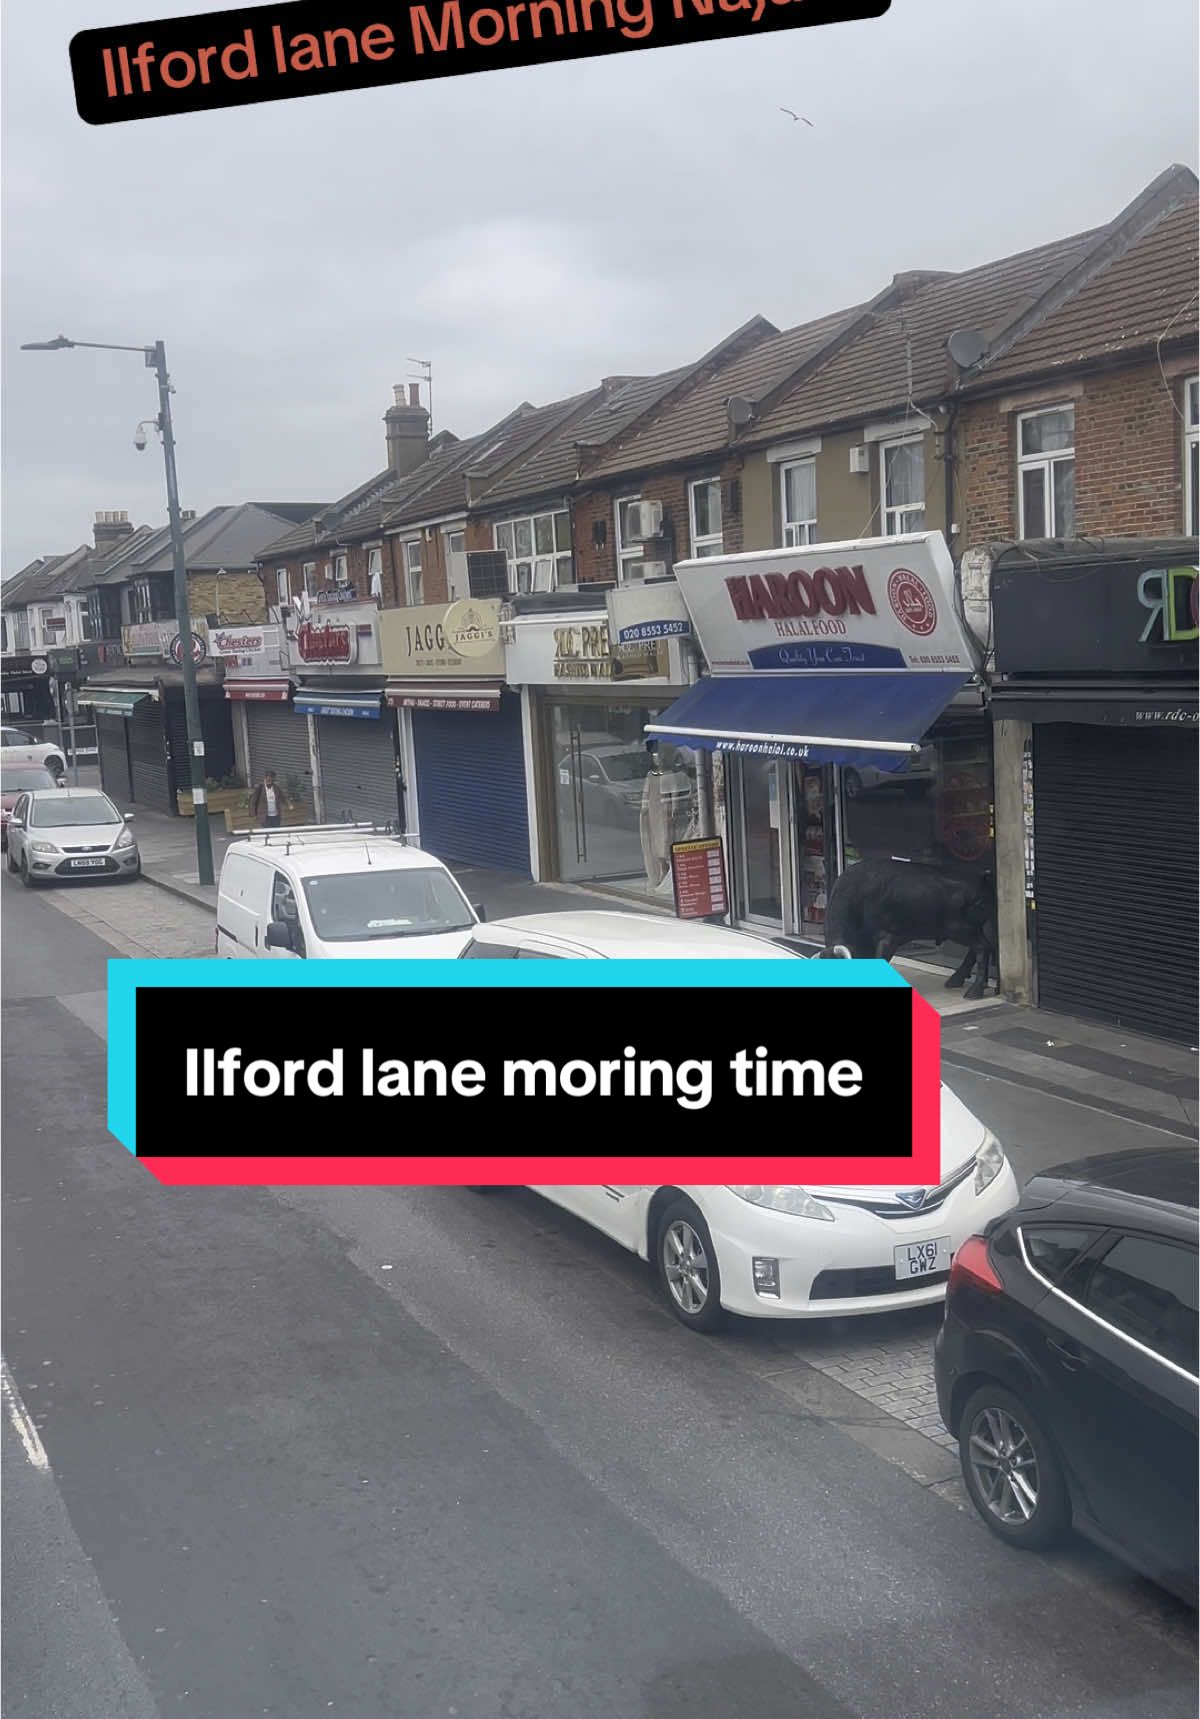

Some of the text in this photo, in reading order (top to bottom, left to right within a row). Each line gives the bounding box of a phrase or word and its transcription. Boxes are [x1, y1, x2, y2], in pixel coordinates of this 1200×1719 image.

[724, 564, 877, 621] HAROON
[623, 628, 640, 640] 020
[774, 619, 847, 637] HALAL FOOD
[406, 623, 446, 656] JAGG
[582, 625, 610, 656] PRE
[715, 739, 811, 758] www.haroonhalal.co.uk
[907, 1241, 938, 1261] LX61
[909, 1256, 937, 1275] GWZ
